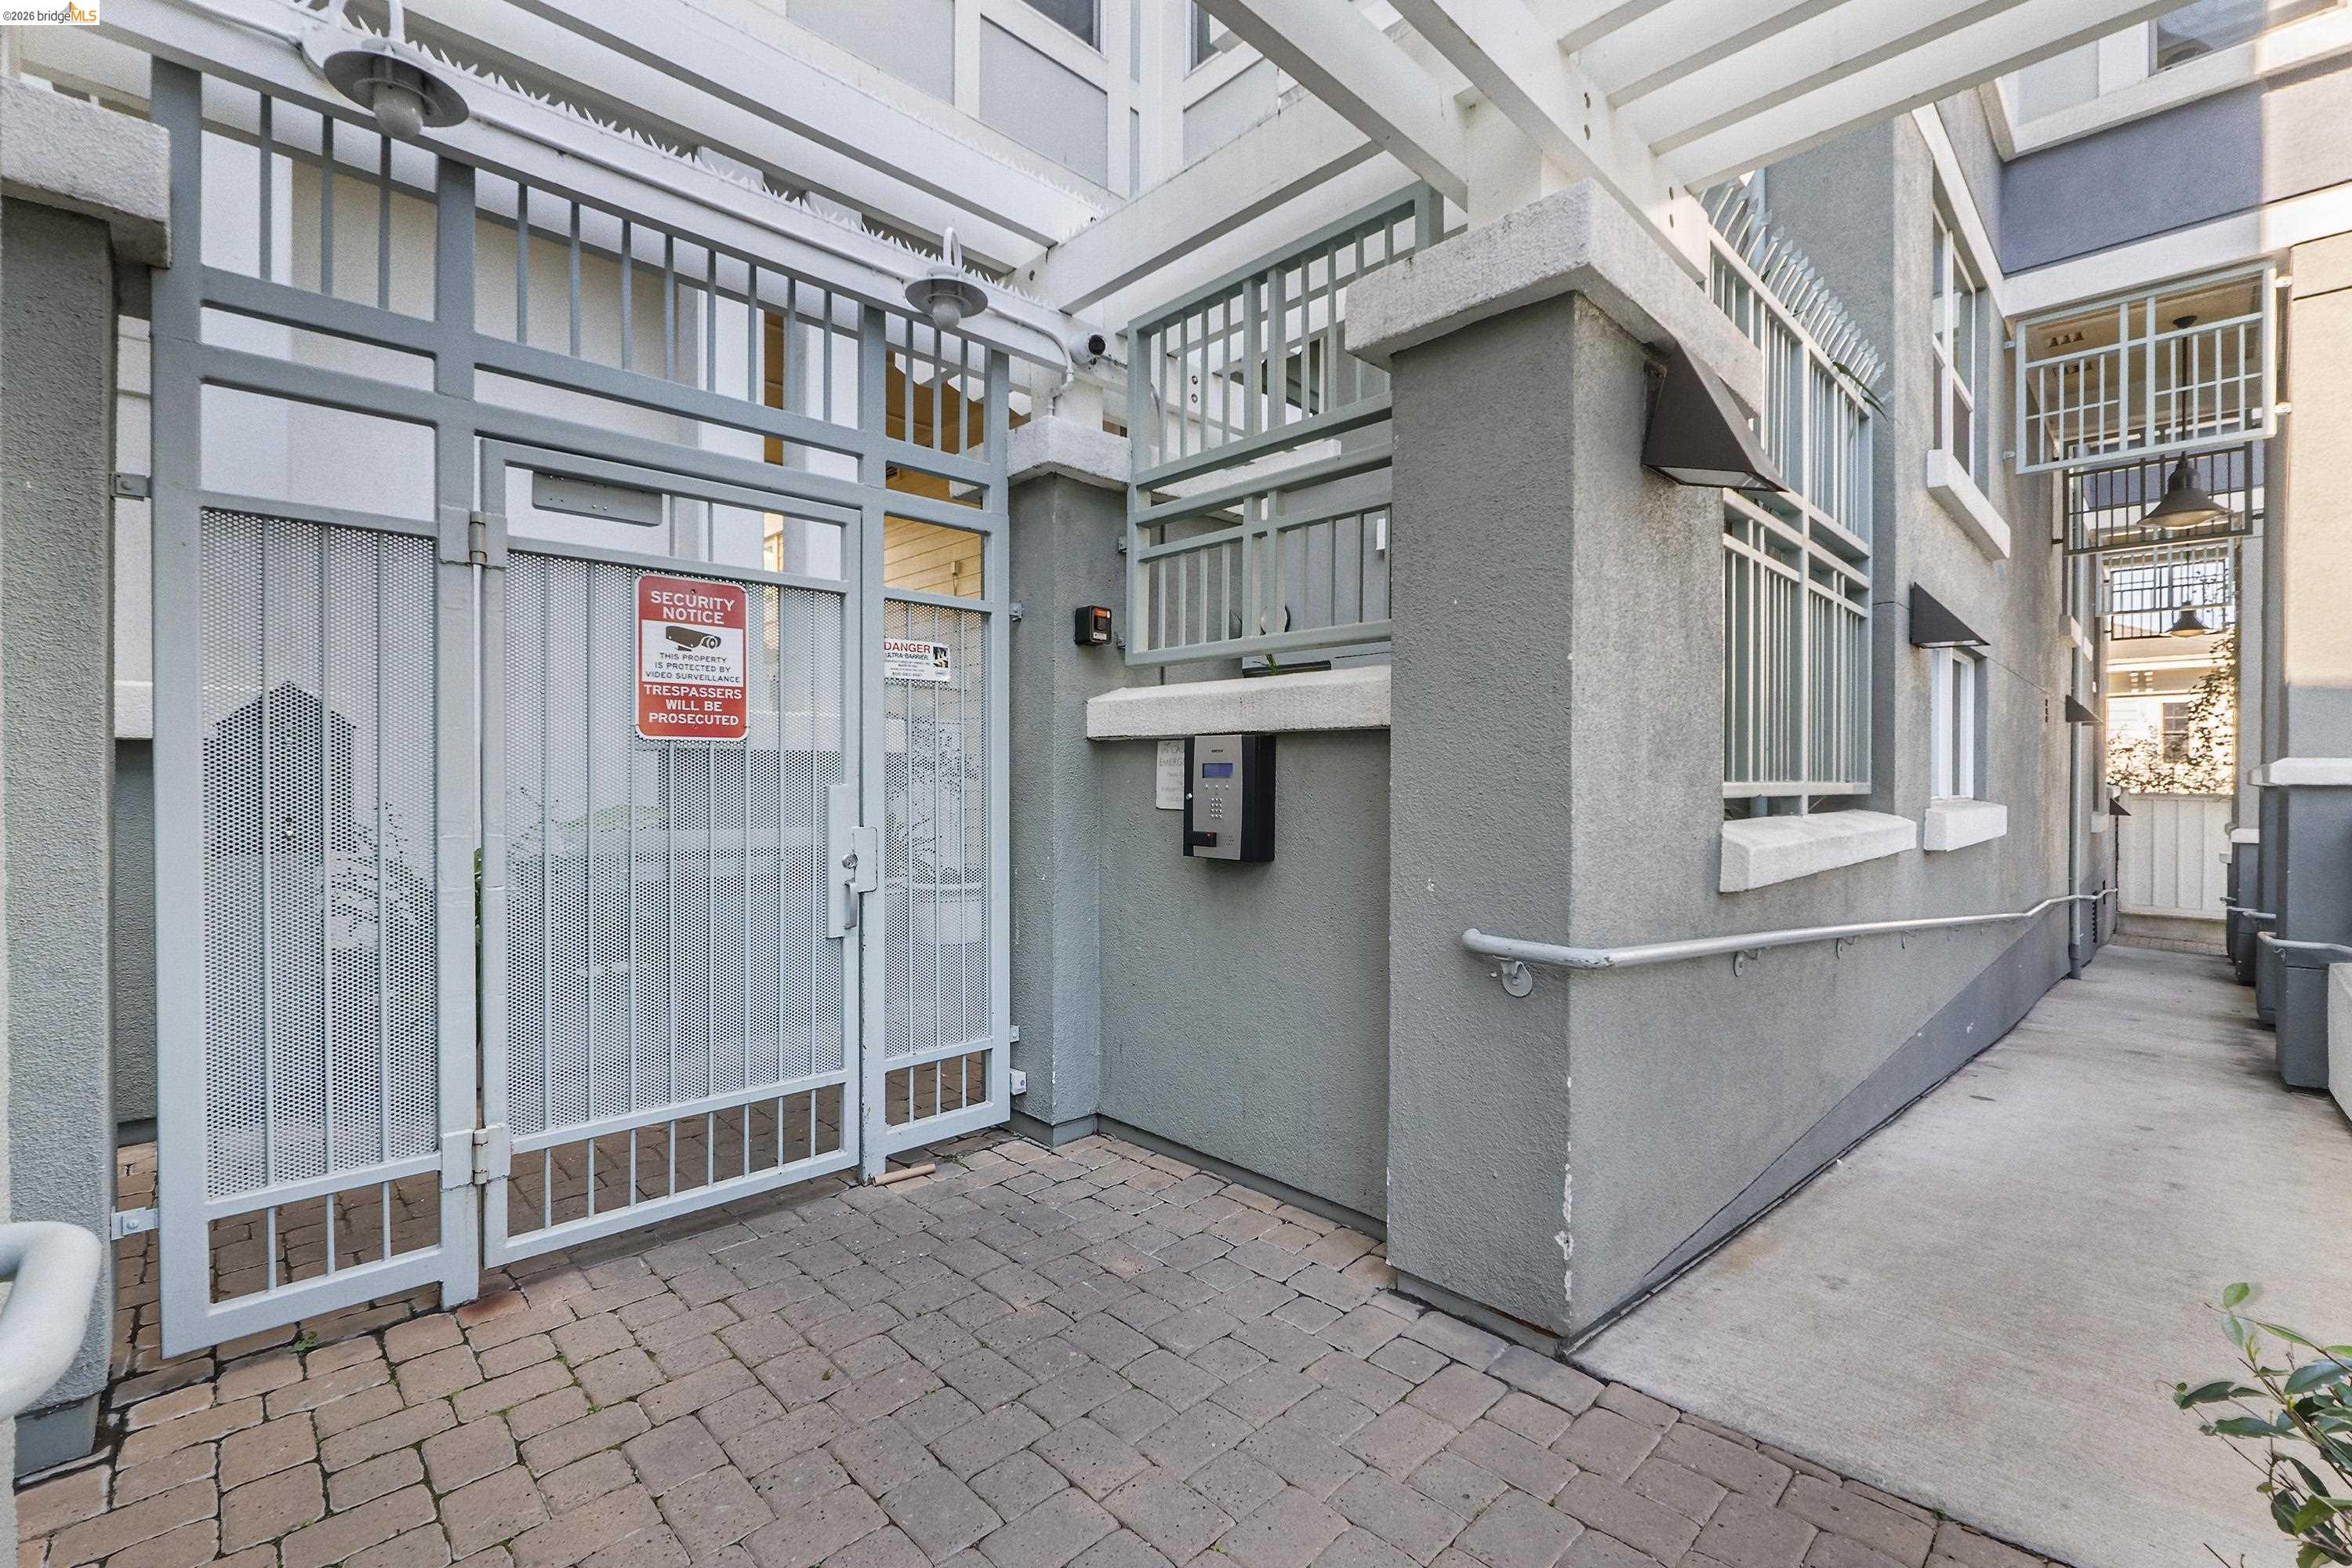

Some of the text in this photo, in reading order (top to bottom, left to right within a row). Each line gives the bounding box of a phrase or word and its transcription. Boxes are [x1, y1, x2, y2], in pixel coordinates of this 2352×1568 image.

[650, 590, 735, 612] SECURITY
[662, 606, 724, 624] NOTICE
[884, 641, 931, 654] DANGER
[682, 654, 727, 664] PROPERTY
[666, 662, 717, 672] PROTECTED
[645, 670, 741, 684] VIDEO SURVEILLANCE
[643, 684, 743, 699] TRESPASSERS
[665, 699, 723, 712] WILL BE
[648, 712, 739, 726] PROSECUTED
